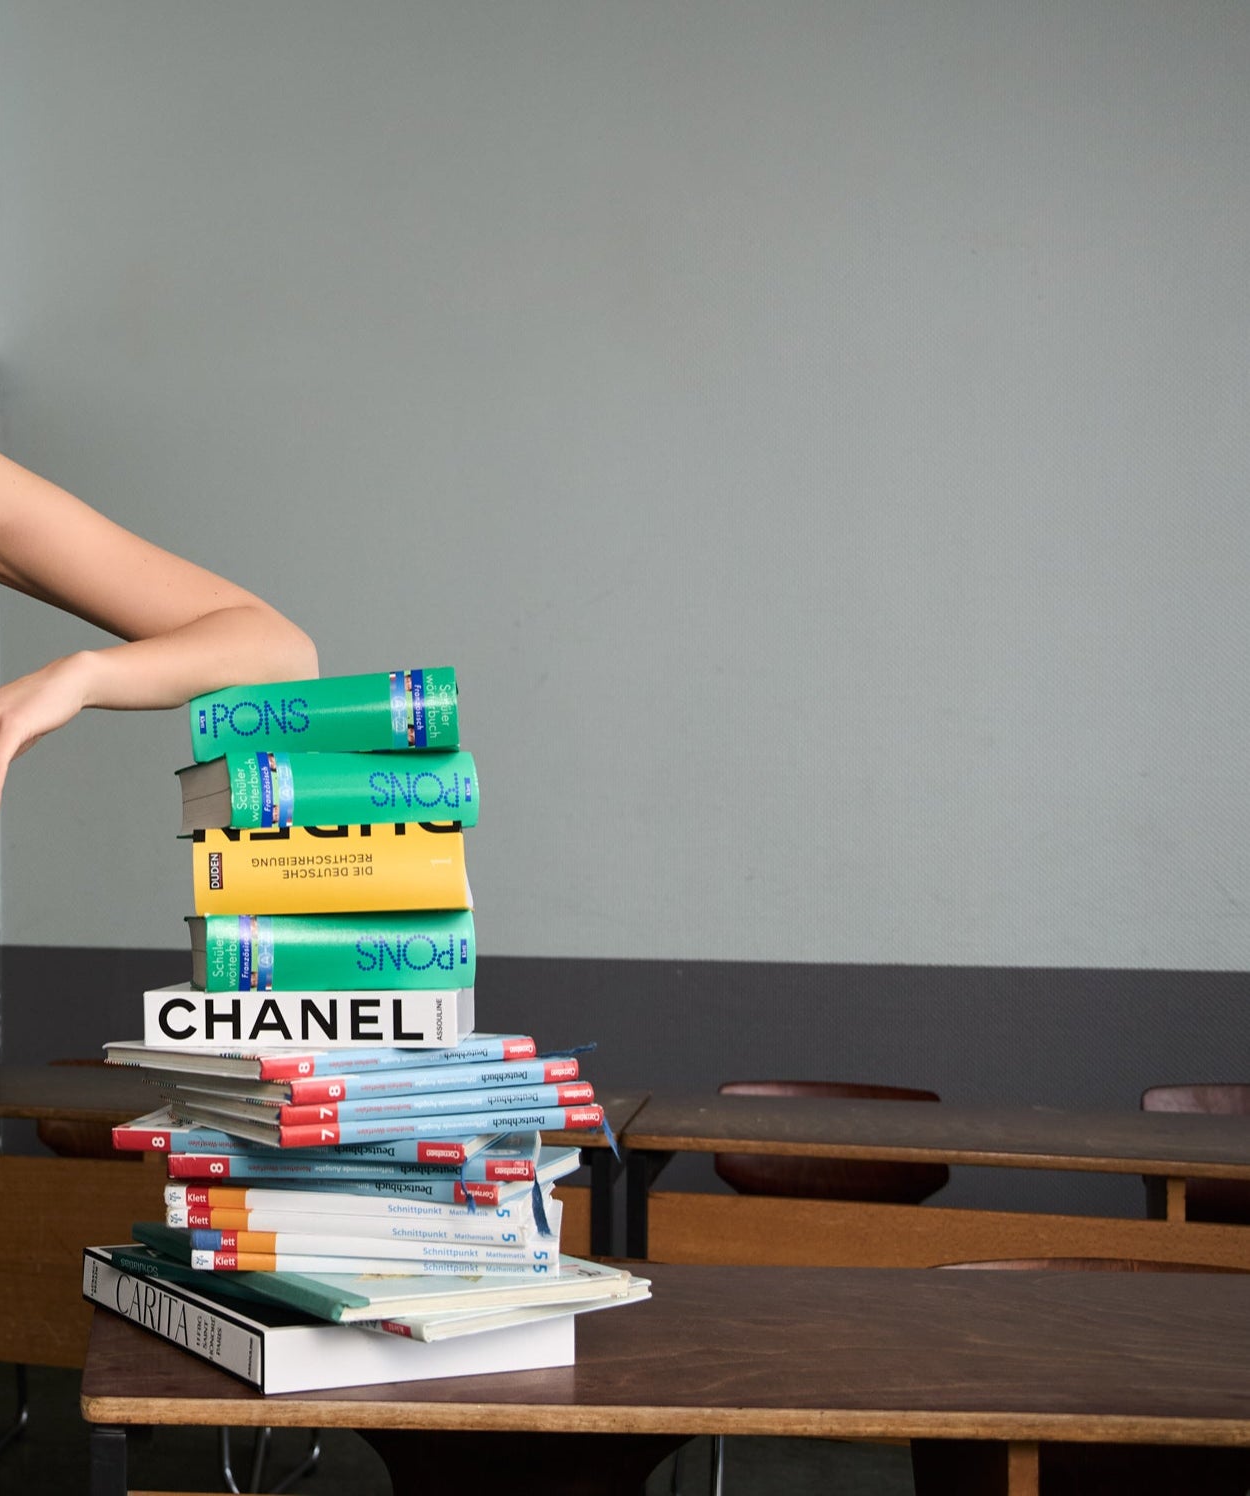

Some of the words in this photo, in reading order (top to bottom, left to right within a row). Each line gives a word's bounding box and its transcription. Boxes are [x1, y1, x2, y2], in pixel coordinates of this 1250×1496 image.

[212, 698, 310, 738] PONS
[235, 768, 248, 810] Schüler
[244, 758, 260, 822] wörterbuch
[261, 766, 271, 812] Französisch
[369, 771, 460, 808] PONS
[251, 853, 374, 868] RECHTSCHREIBUNG
[211, 854, 220, 889] DUDEN
[283, 867, 349, 880] DEUTSCHE
[356, 867, 374, 877] DIE
[212, 936, 224, 978] Schüler
[356, 934, 454, 972] PONS
[158, 998, 424, 1041] CHANEL
[444, 1049, 488, 1060] Deutschbuch
[298, 1062, 311, 1073] 8
[481, 1072, 528, 1083] Deutschbuch
[328, 1085, 341, 1097] 8
[488, 1092, 539, 1105] Deutschbuch
[320, 1107, 333, 1119] 7
[571, 1113, 599, 1122] Cornelsen
[493, 1115, 545, 1128] Deutschbuch
[321, 1129, 335, 1140] 7
[151, 1136, 165, 1148] 8
[334, 1145, 396, 1156] Deutschbuch
[426, 1149, 460, 1158] Cornelsen
[210, 1163, 223, 1173] 8
[400, 1165, 462, 1176] Deutschbuch
[494, 1166, 529, 1176] Cornelsen
[375, 1182, 433, 1195] Deutschbuch
[187, 1193, 207, 1203] Klett
[388, 1204, 442, 1216] Schnittpunkt
[496, 1209, 510, 1218] 5
[189, 1215, 209, 1225] Klett
[392, 1228, 447, 1239] Schnittpunkt
[454, 1232, 494, 1241] Mathematik
[501, 1233, 516, 1242] 5
[221, 1237, 235, 1246] lett
[423, 1247, 478, 1258] Schnittpunkt
[486, 1251, 525, 1259] Mathematik
[533, 1251, 548, 1260] 5
[215, 1256, 235, 1265] Klett
[120, 1258, 159, 1278] Schulatlas
[423, 1263, 478, 1273] Schnittpunkt
[486, 1265, 525, 1273] Mathematik
[533, 1265, 547, 1273] 5
[116, 1274, 188, 1346] CARITA
